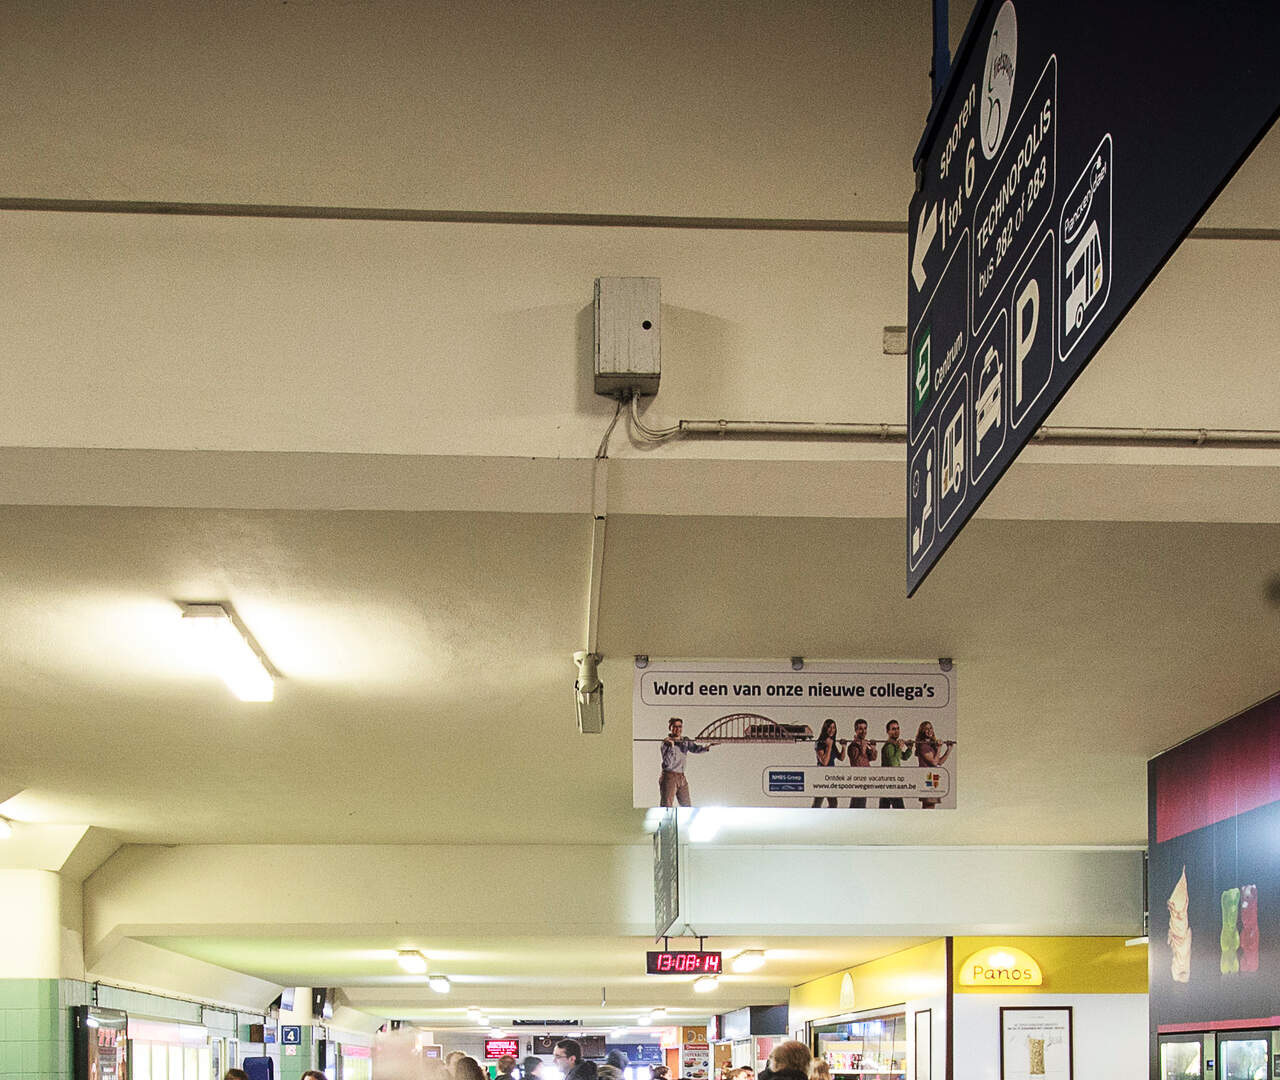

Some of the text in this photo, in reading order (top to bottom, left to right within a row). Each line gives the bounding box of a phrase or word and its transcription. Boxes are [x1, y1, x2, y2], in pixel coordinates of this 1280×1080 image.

[940, 83, 976, 179] sporen
[940, 137, 976, 250] 1 tot 6
[977, 98, 1051, 257] TECHNOPOLIS
[979, 155, 1046, 298] bus 282 of 283
[935, 331, 963, 392] Centrum
[1016, 279, 1040, 407] P
[654, 681, 935, 701] Word een van onze nieuwe collega's
[825, 774, 845, 782] Ontdek
[898, 775, 905, 783] op
[657, 954, 719, 971] 13:08:14
[973, 965, 1032, 980] Panos
[287, 1030, 295, 1041] 4
